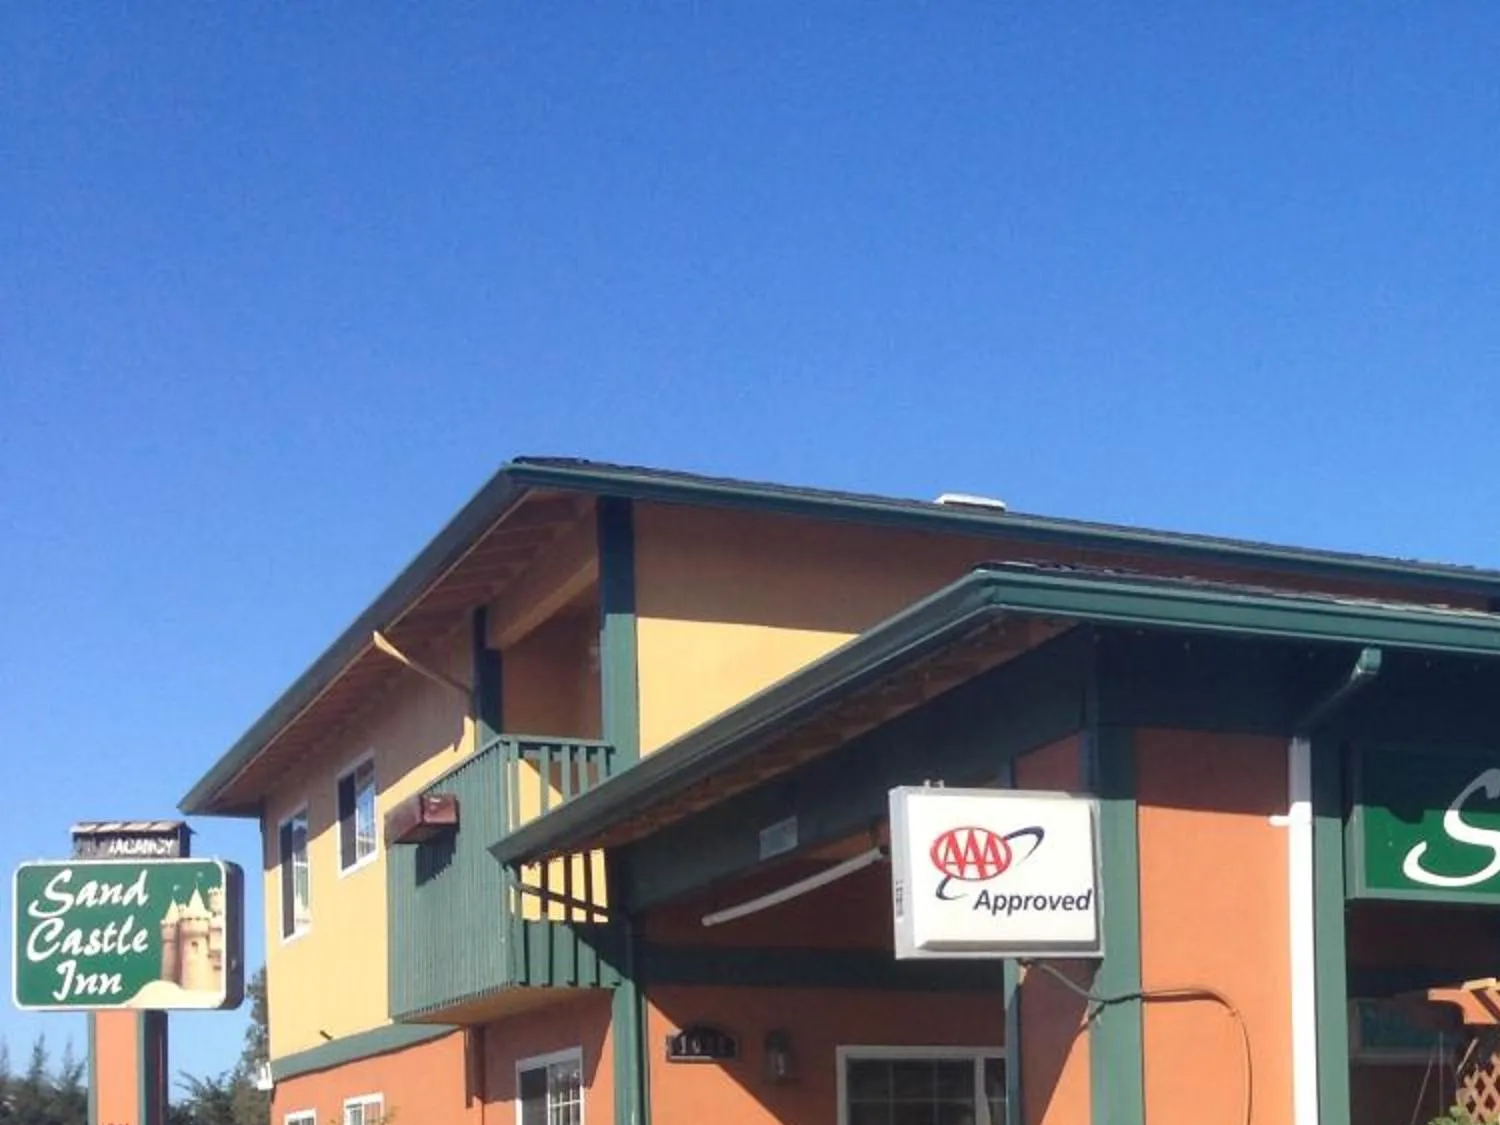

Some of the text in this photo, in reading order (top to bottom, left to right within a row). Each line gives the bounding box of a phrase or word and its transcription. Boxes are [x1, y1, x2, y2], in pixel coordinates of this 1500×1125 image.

[940, 827, 1005, 880] AAA
[28, 869, 149, 918] Sand
[972, 889, 1093, 917] Approved
[27, 915, 149, 962] Castle
[52, 960, 123, 1001] Inn
